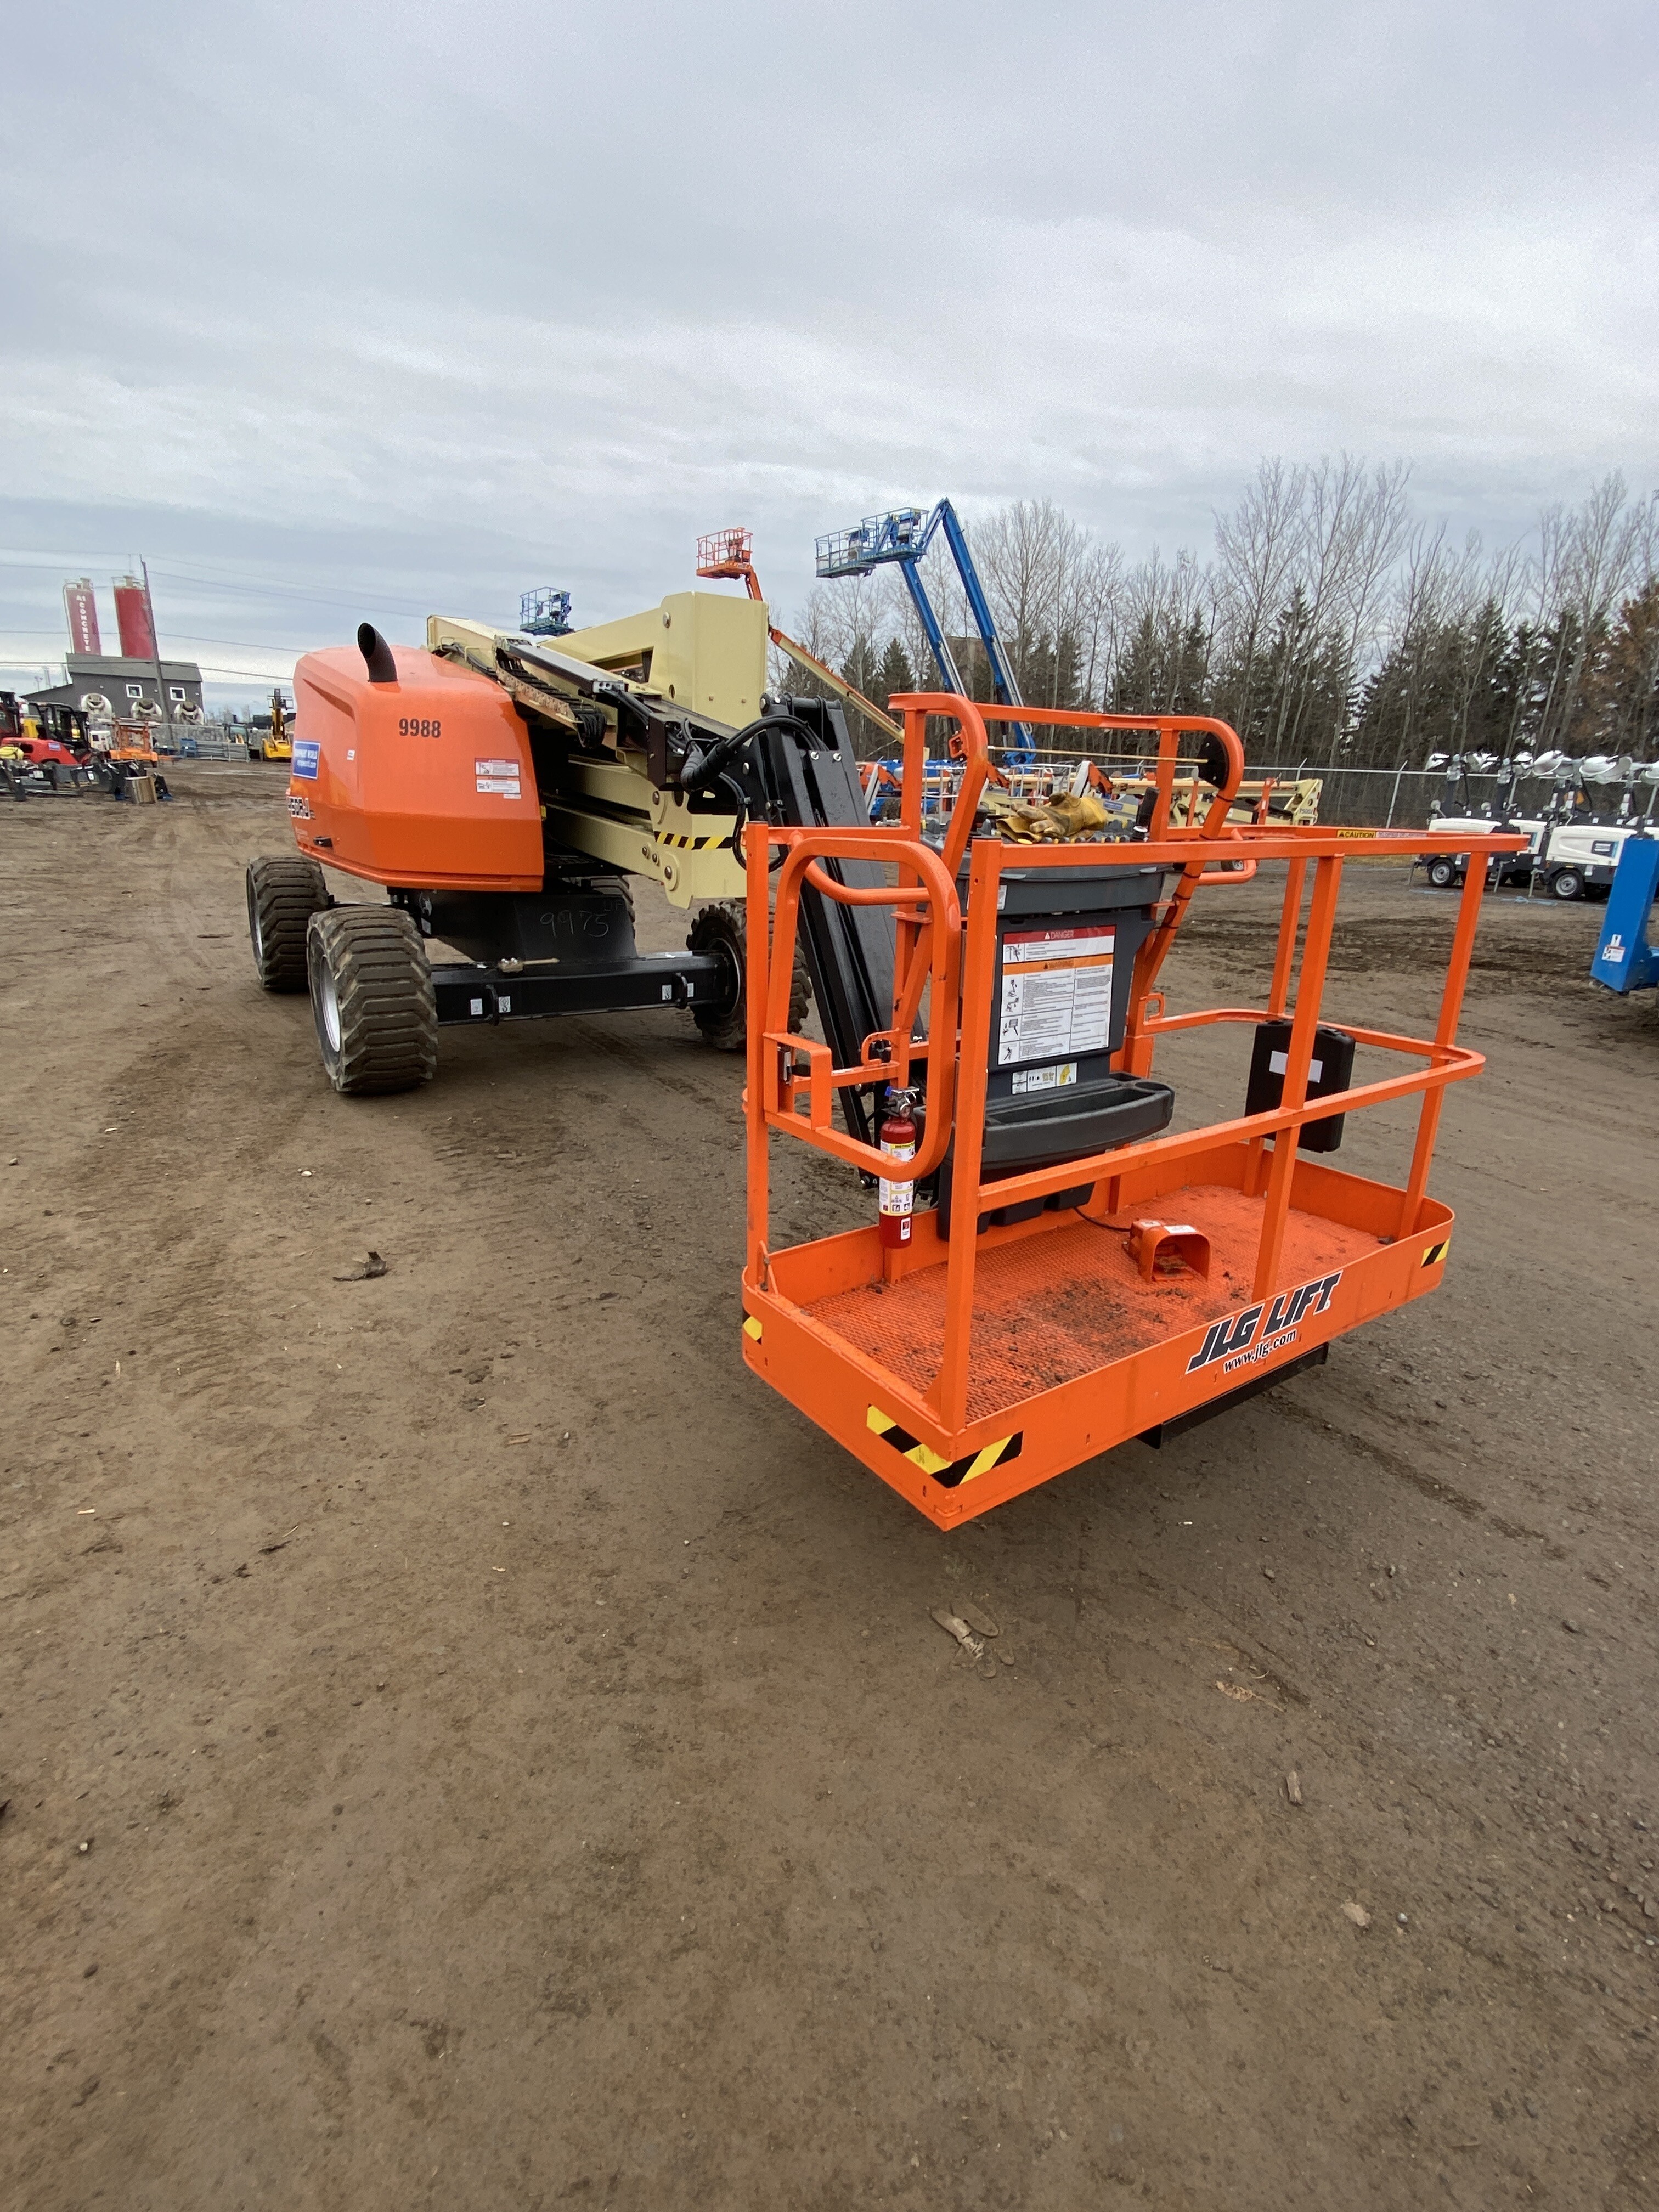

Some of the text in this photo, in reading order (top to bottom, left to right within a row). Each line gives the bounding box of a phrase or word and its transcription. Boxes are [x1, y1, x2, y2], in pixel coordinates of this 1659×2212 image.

[79, 602, 91, 651] CONCRETE
[399, 718, 441, 737] 9988
[540, 910, 609, 938] 9975
[1051, 930, 1074, 939] DANGER
[1185, 1269, 1343, 1374] JLG LIFT
[1224, 1329, 1297, 1373] www.jlg.com
